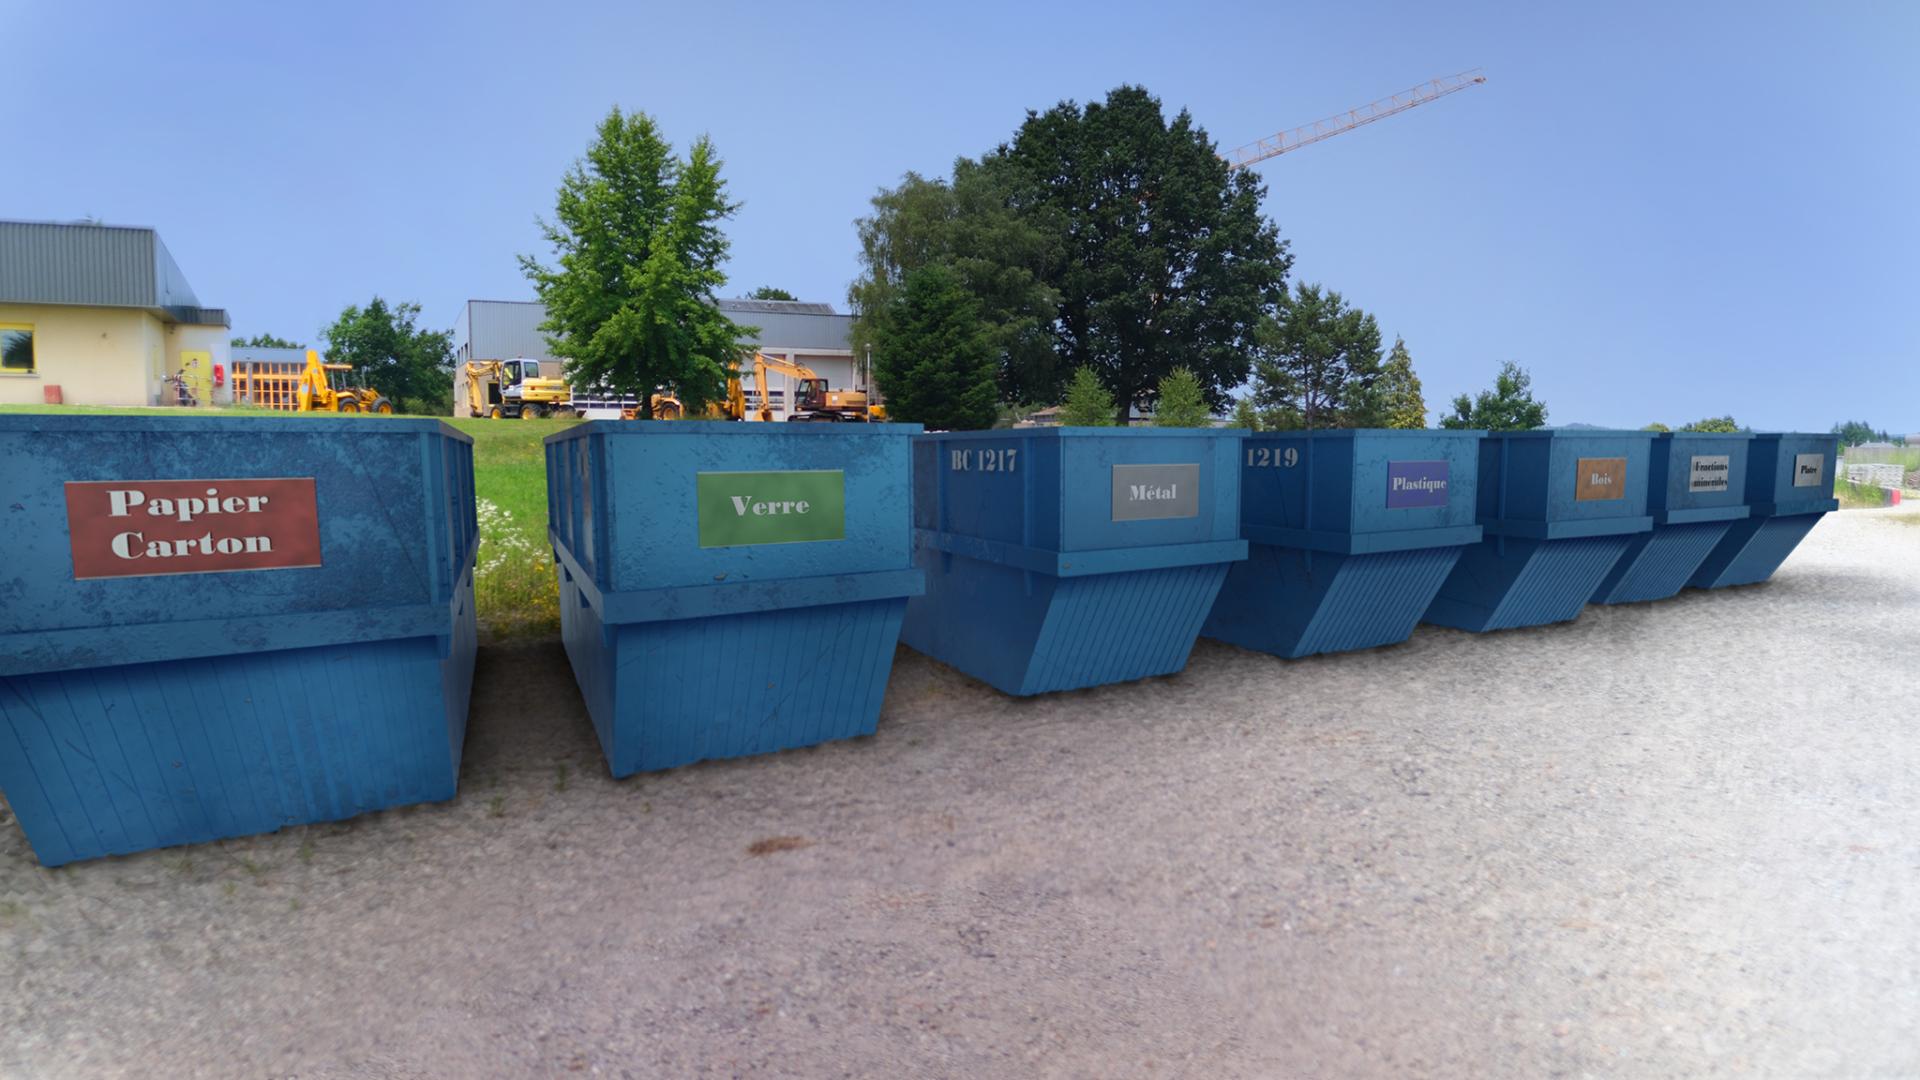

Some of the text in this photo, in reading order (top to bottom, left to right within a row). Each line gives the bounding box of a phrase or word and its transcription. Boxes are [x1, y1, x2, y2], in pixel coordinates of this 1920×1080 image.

[952, 448, 1017, 472] BC 1217
[1248, 448, 1298, 467] 1219
[1392, 476, 1447, 493] Plastique
[1591, 473, 1612, 486] Bois
[1129, 483, 1177, 502] Métal
[106, 488, 269, 522] Papier
[730, 495, 810, 517] Verre
[111, 531, 273, 560] Carton
